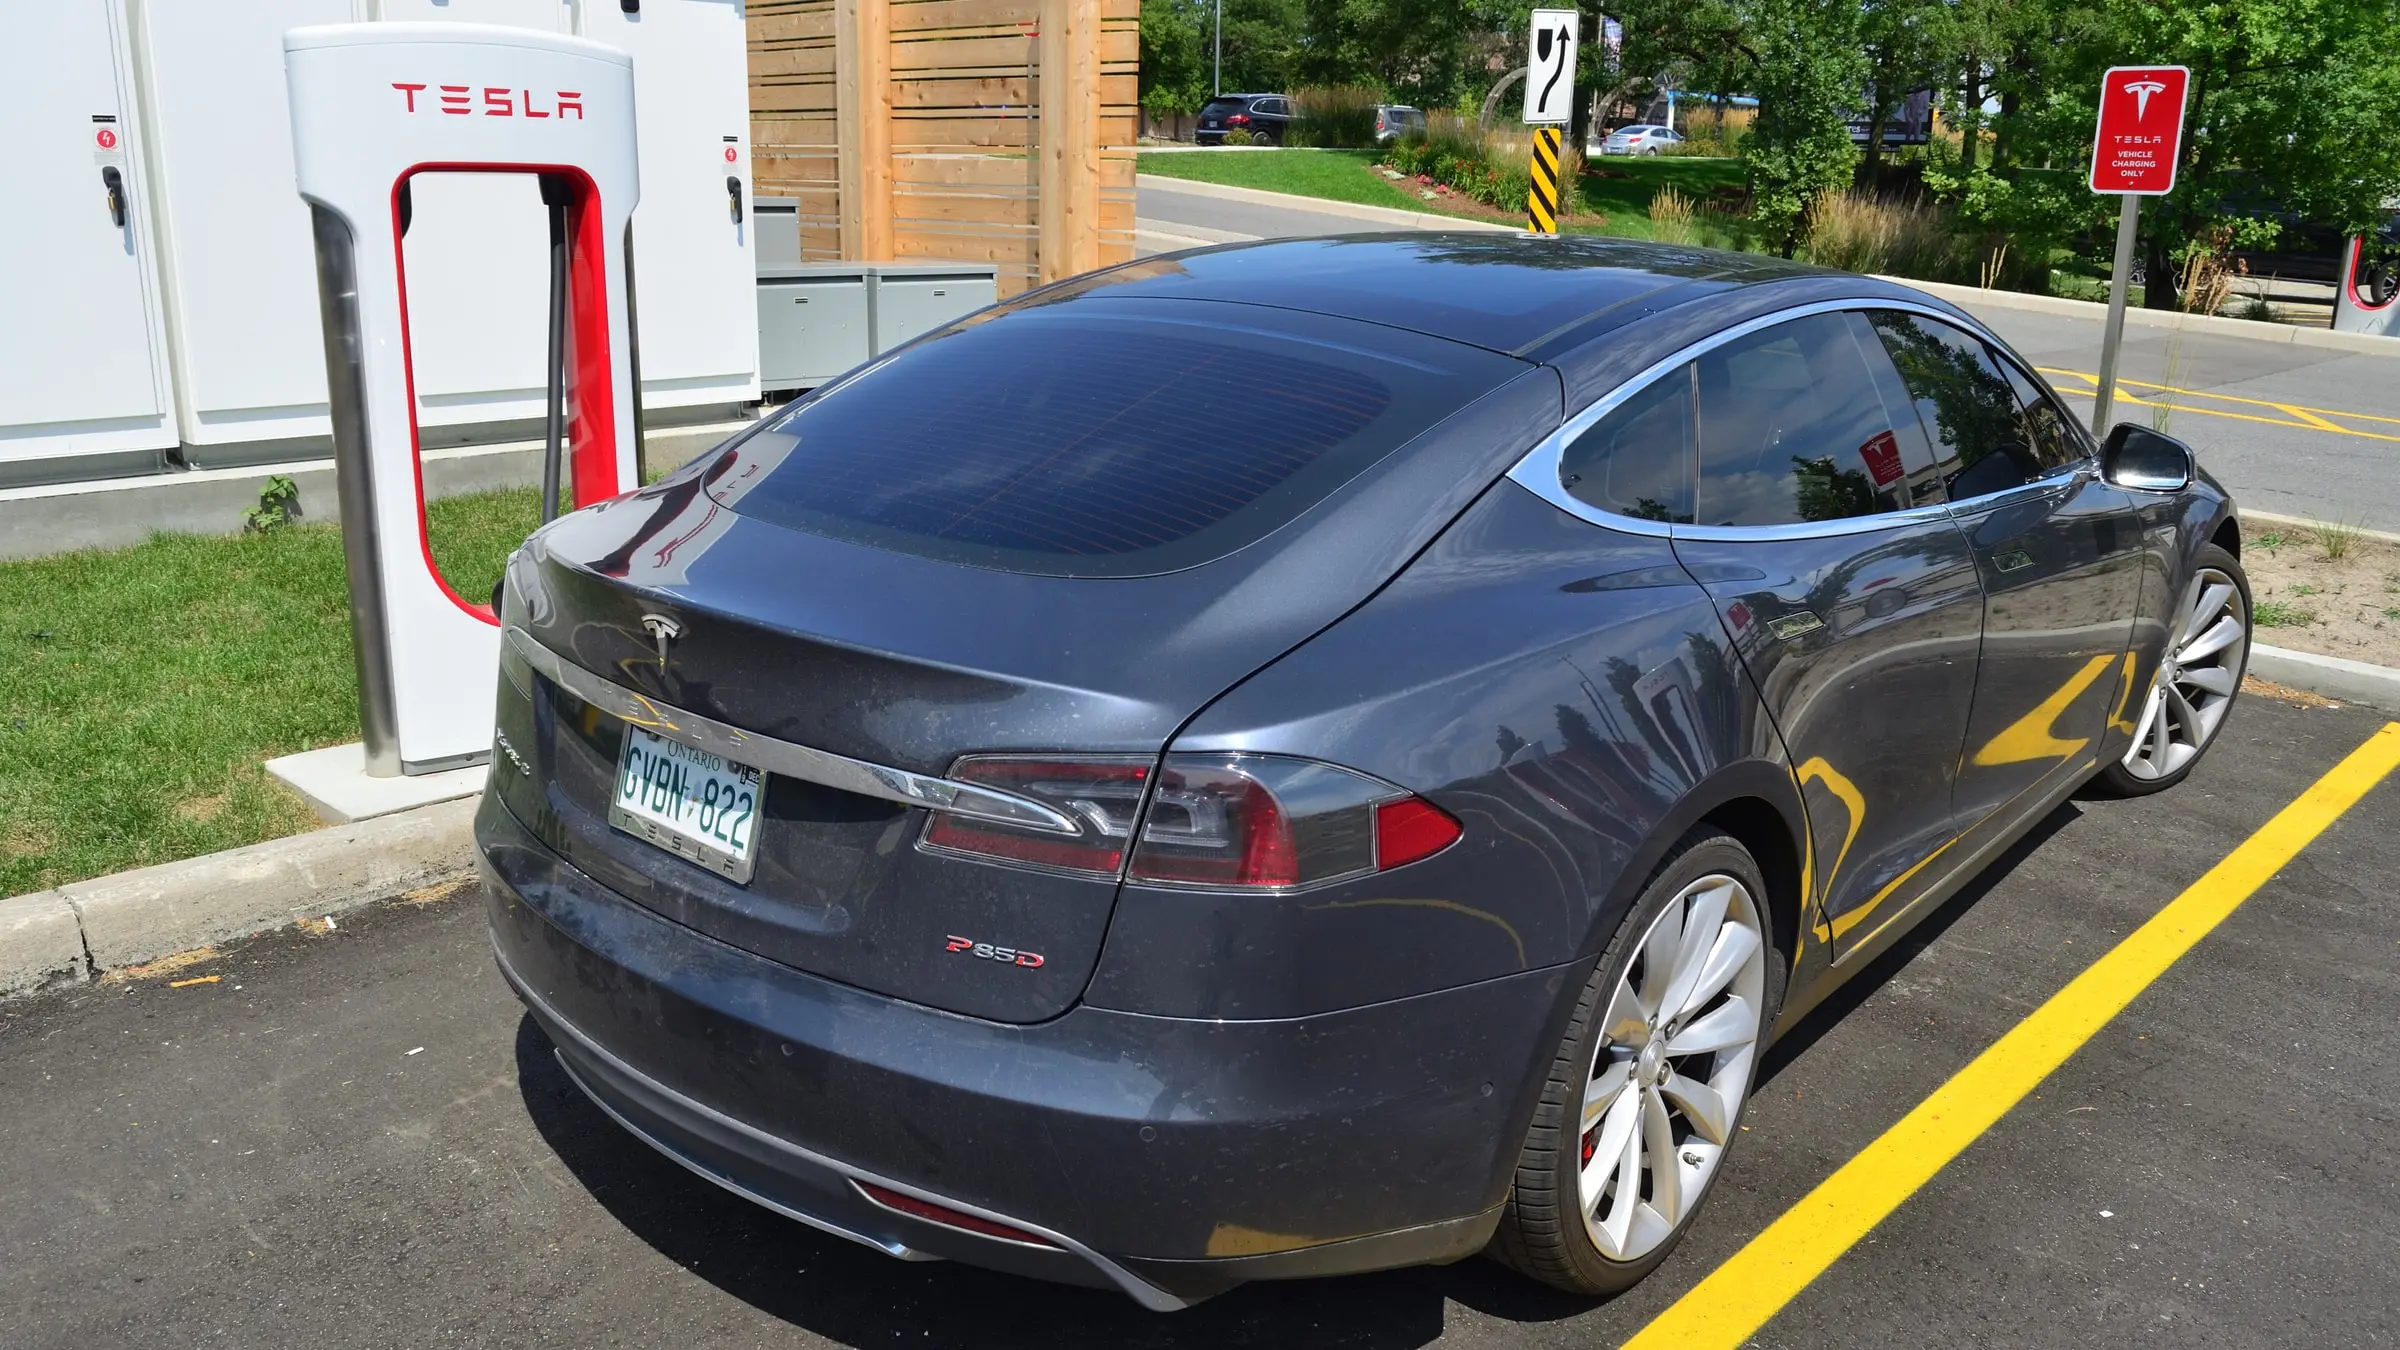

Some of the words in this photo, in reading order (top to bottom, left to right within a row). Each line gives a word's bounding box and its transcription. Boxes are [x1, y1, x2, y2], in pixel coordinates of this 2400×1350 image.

[391, 82, 583, 120] TESLA
[2113, 135, 2162, 144] TESLA
[2112, 160, 2156, 168] CHARGING
[667, 739, 721, 772] ONTARIO
[622, 813, 735, 875] TESLA
[946, 934, 1044, 968] P85D
